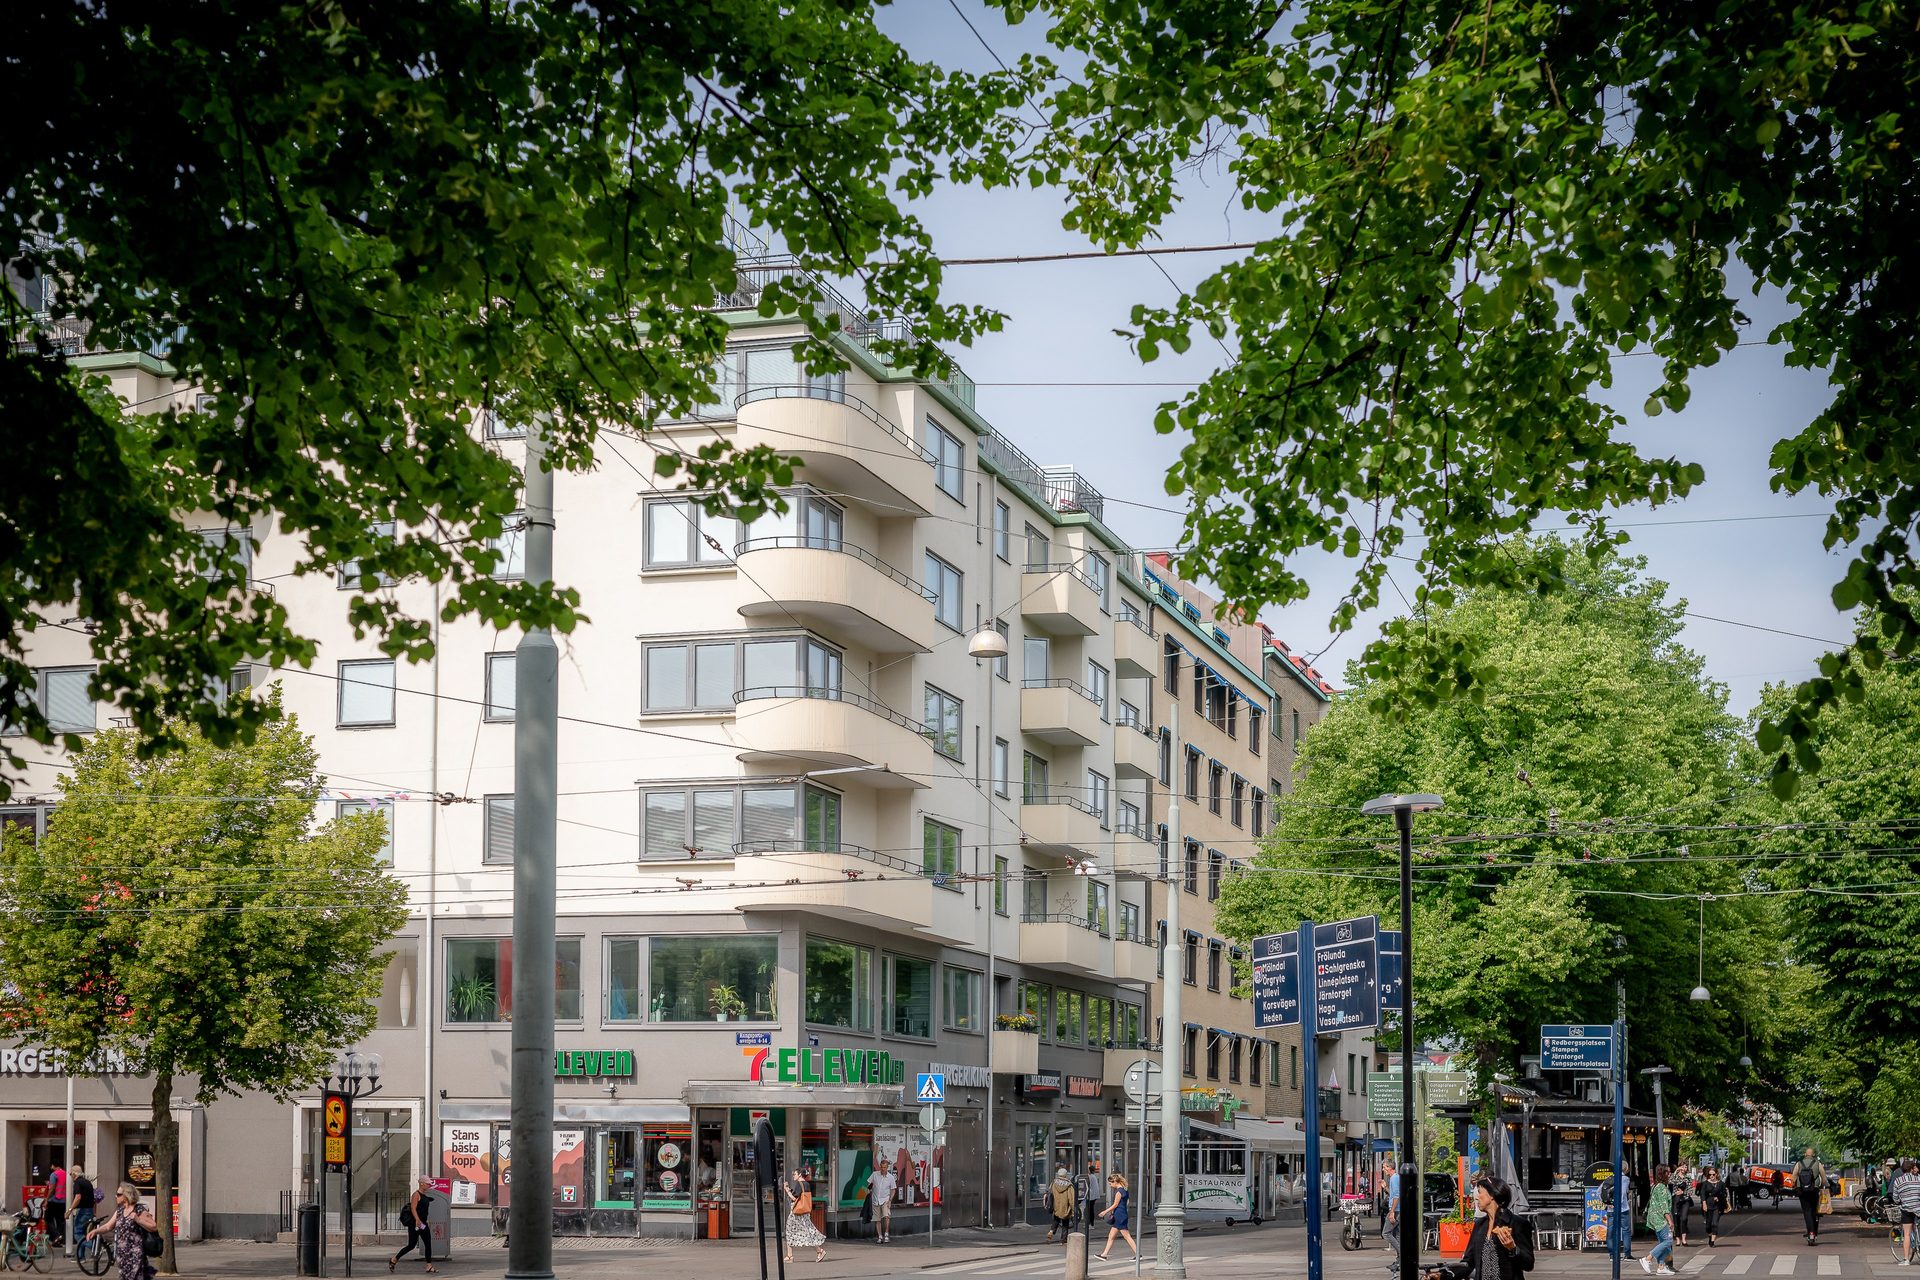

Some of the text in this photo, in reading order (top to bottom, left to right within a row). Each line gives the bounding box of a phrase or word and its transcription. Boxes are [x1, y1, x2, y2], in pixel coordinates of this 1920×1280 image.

[1317, 949, 1346, 962] Frölunda
[1262, 960, 1286, 972] Mölndal
[1325, 959, 1366, 975] Sahlgrenska
[1262, 973, 1286, 986] Örgryte
[1318, 973, 1359, 989] Linnéplatsen
[1262, 987, 1281, 998] Ullevi
[1318, 989, 1352, 1002] Järntorget
[1262, 998, 1297, 1012] Korsvägen
[1318, 1004, 1336, 1016] Haga
[1263, 1013, 1283, 1024] Heden
[1319, 1014, 1360, 1028] Vasapatsen
[1551, 1039, 1606, 1048] Redbergsplatsen
[1551, 1046, 1579, 1054] Stampen
[1551, 1053, 1584, 1062] Järntorget
[1551, 1060, 1609, 1070] Kungsportsplatsen
[358, 1116, 371, 1126] 14
[452, 1129, 480, 1141] Stans
[452, 1141, 479, 1154] bästa
[451, 1155, 476, 1169] kopp
[1187, 1179, 1244, 1188] RESTAURANG
